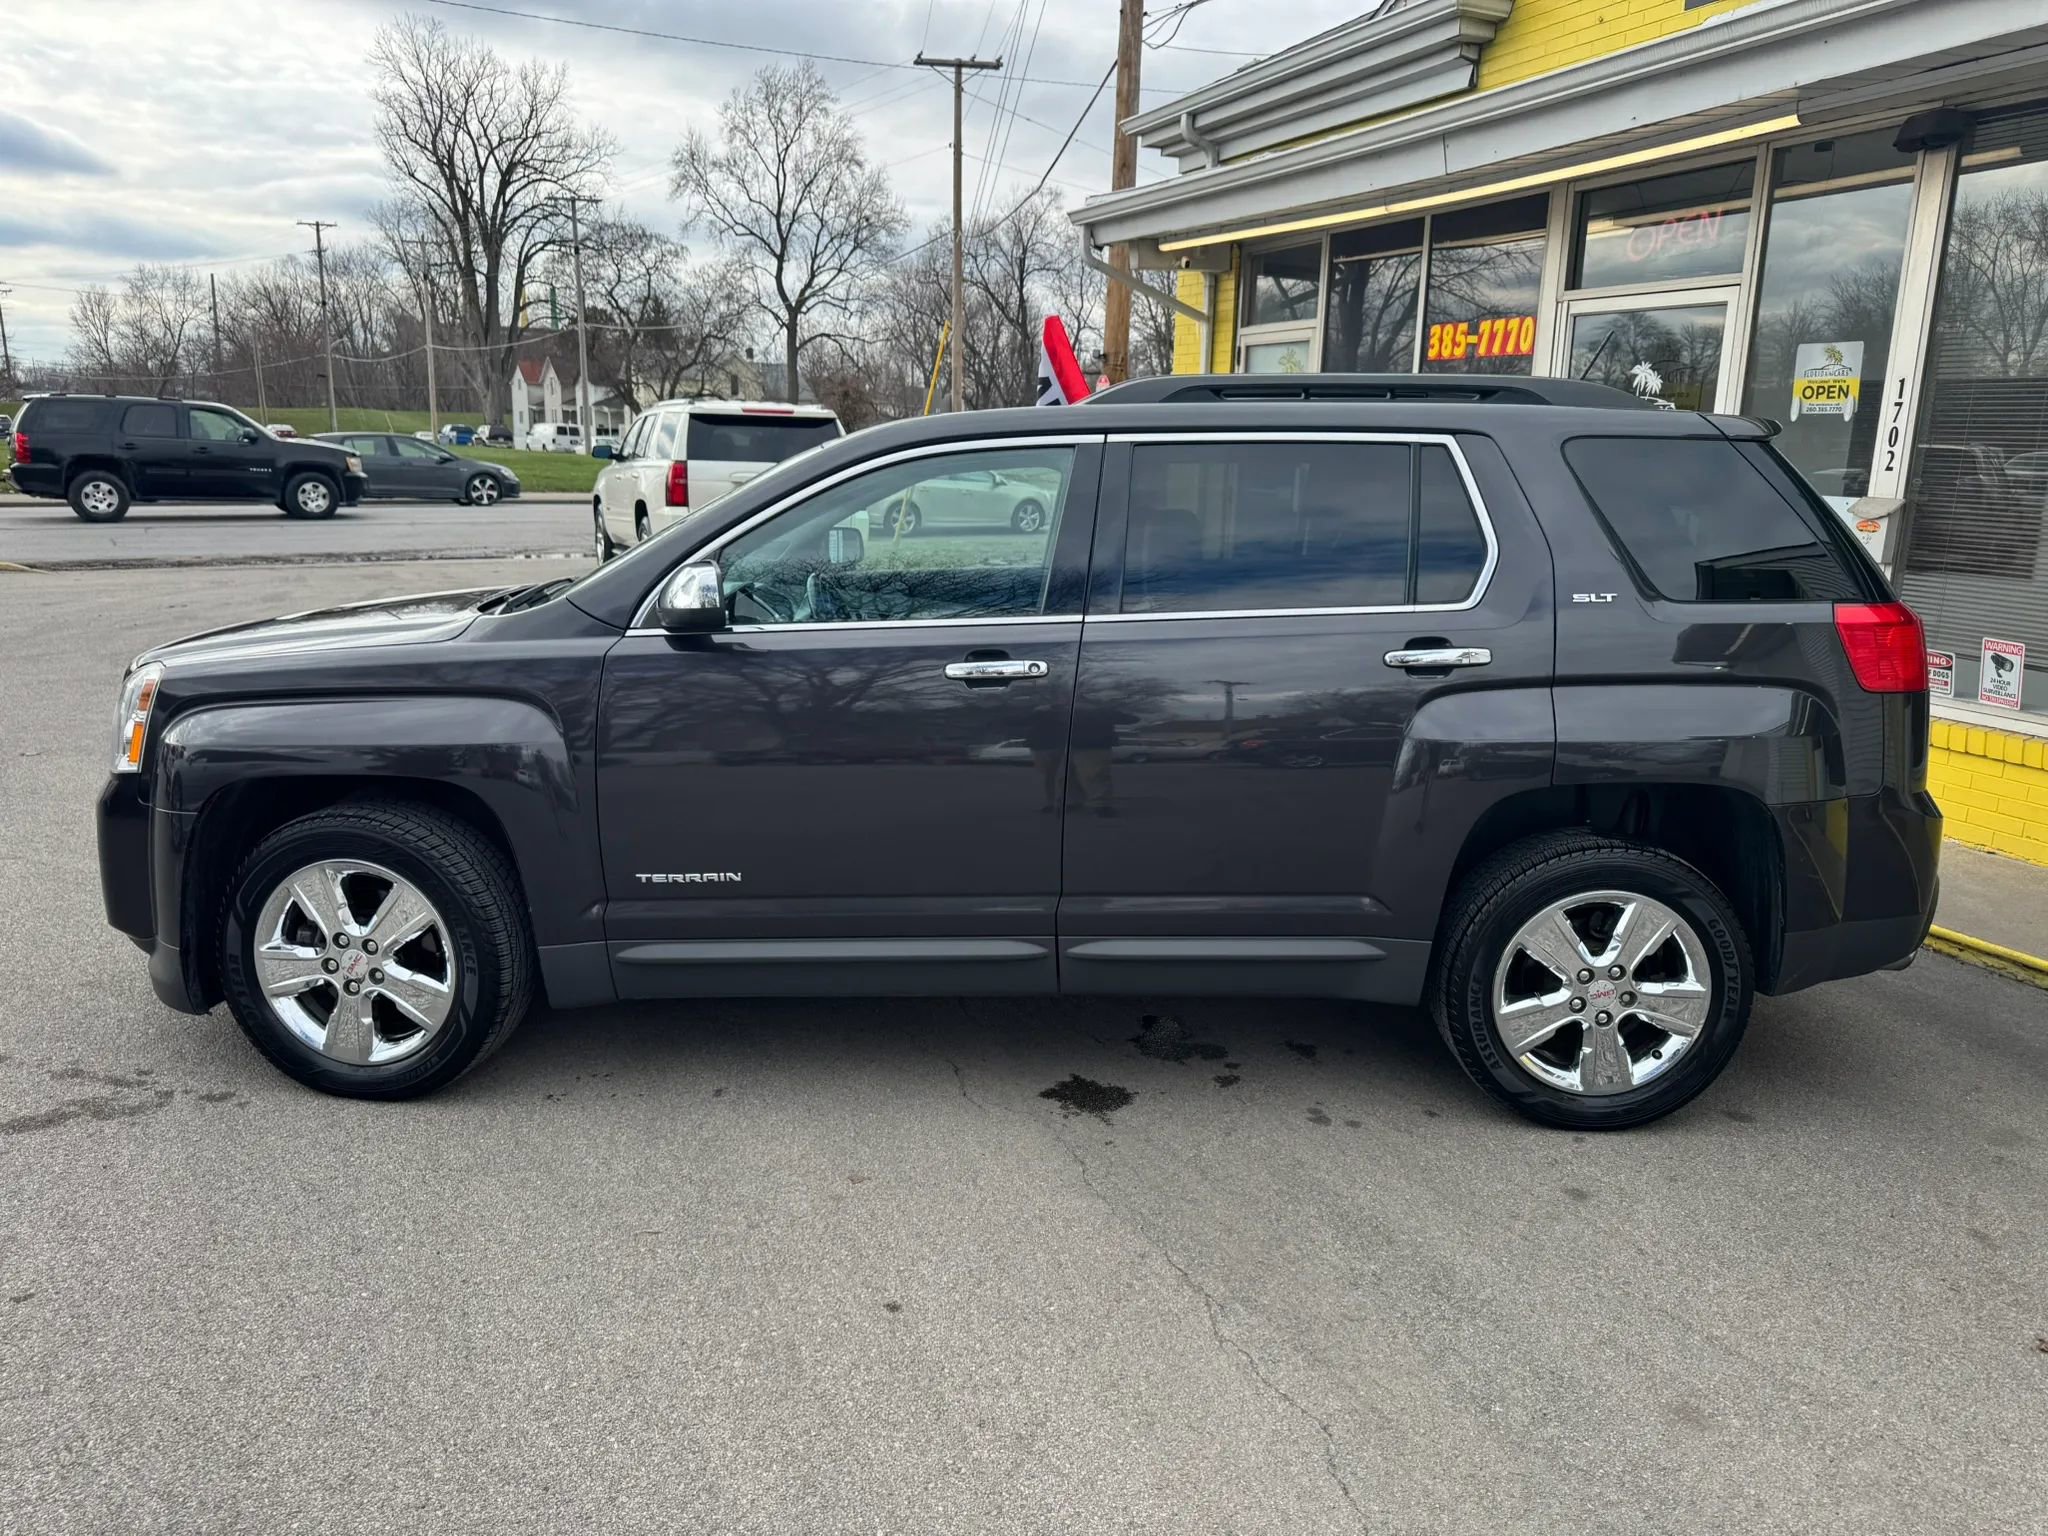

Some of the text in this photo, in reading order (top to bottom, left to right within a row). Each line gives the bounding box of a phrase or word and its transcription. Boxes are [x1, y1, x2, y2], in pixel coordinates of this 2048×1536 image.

[1627, 208, 1725, 263] OPEN
[1427, 316, 1535, 359] 385-7770
[1802, 384, 1850, 400] OPEN
[1884, 377, 1906, 472] 1702
[1572, 593, 1618, 603] SLT
[1985, 640, 2023, 656] WARNING
[635, 872, 742, 883] TERRAIN
[1708, 917, 1740, 1020] GOODYEAR
[1467, 974, 1504, 1072] ASSURANCE
